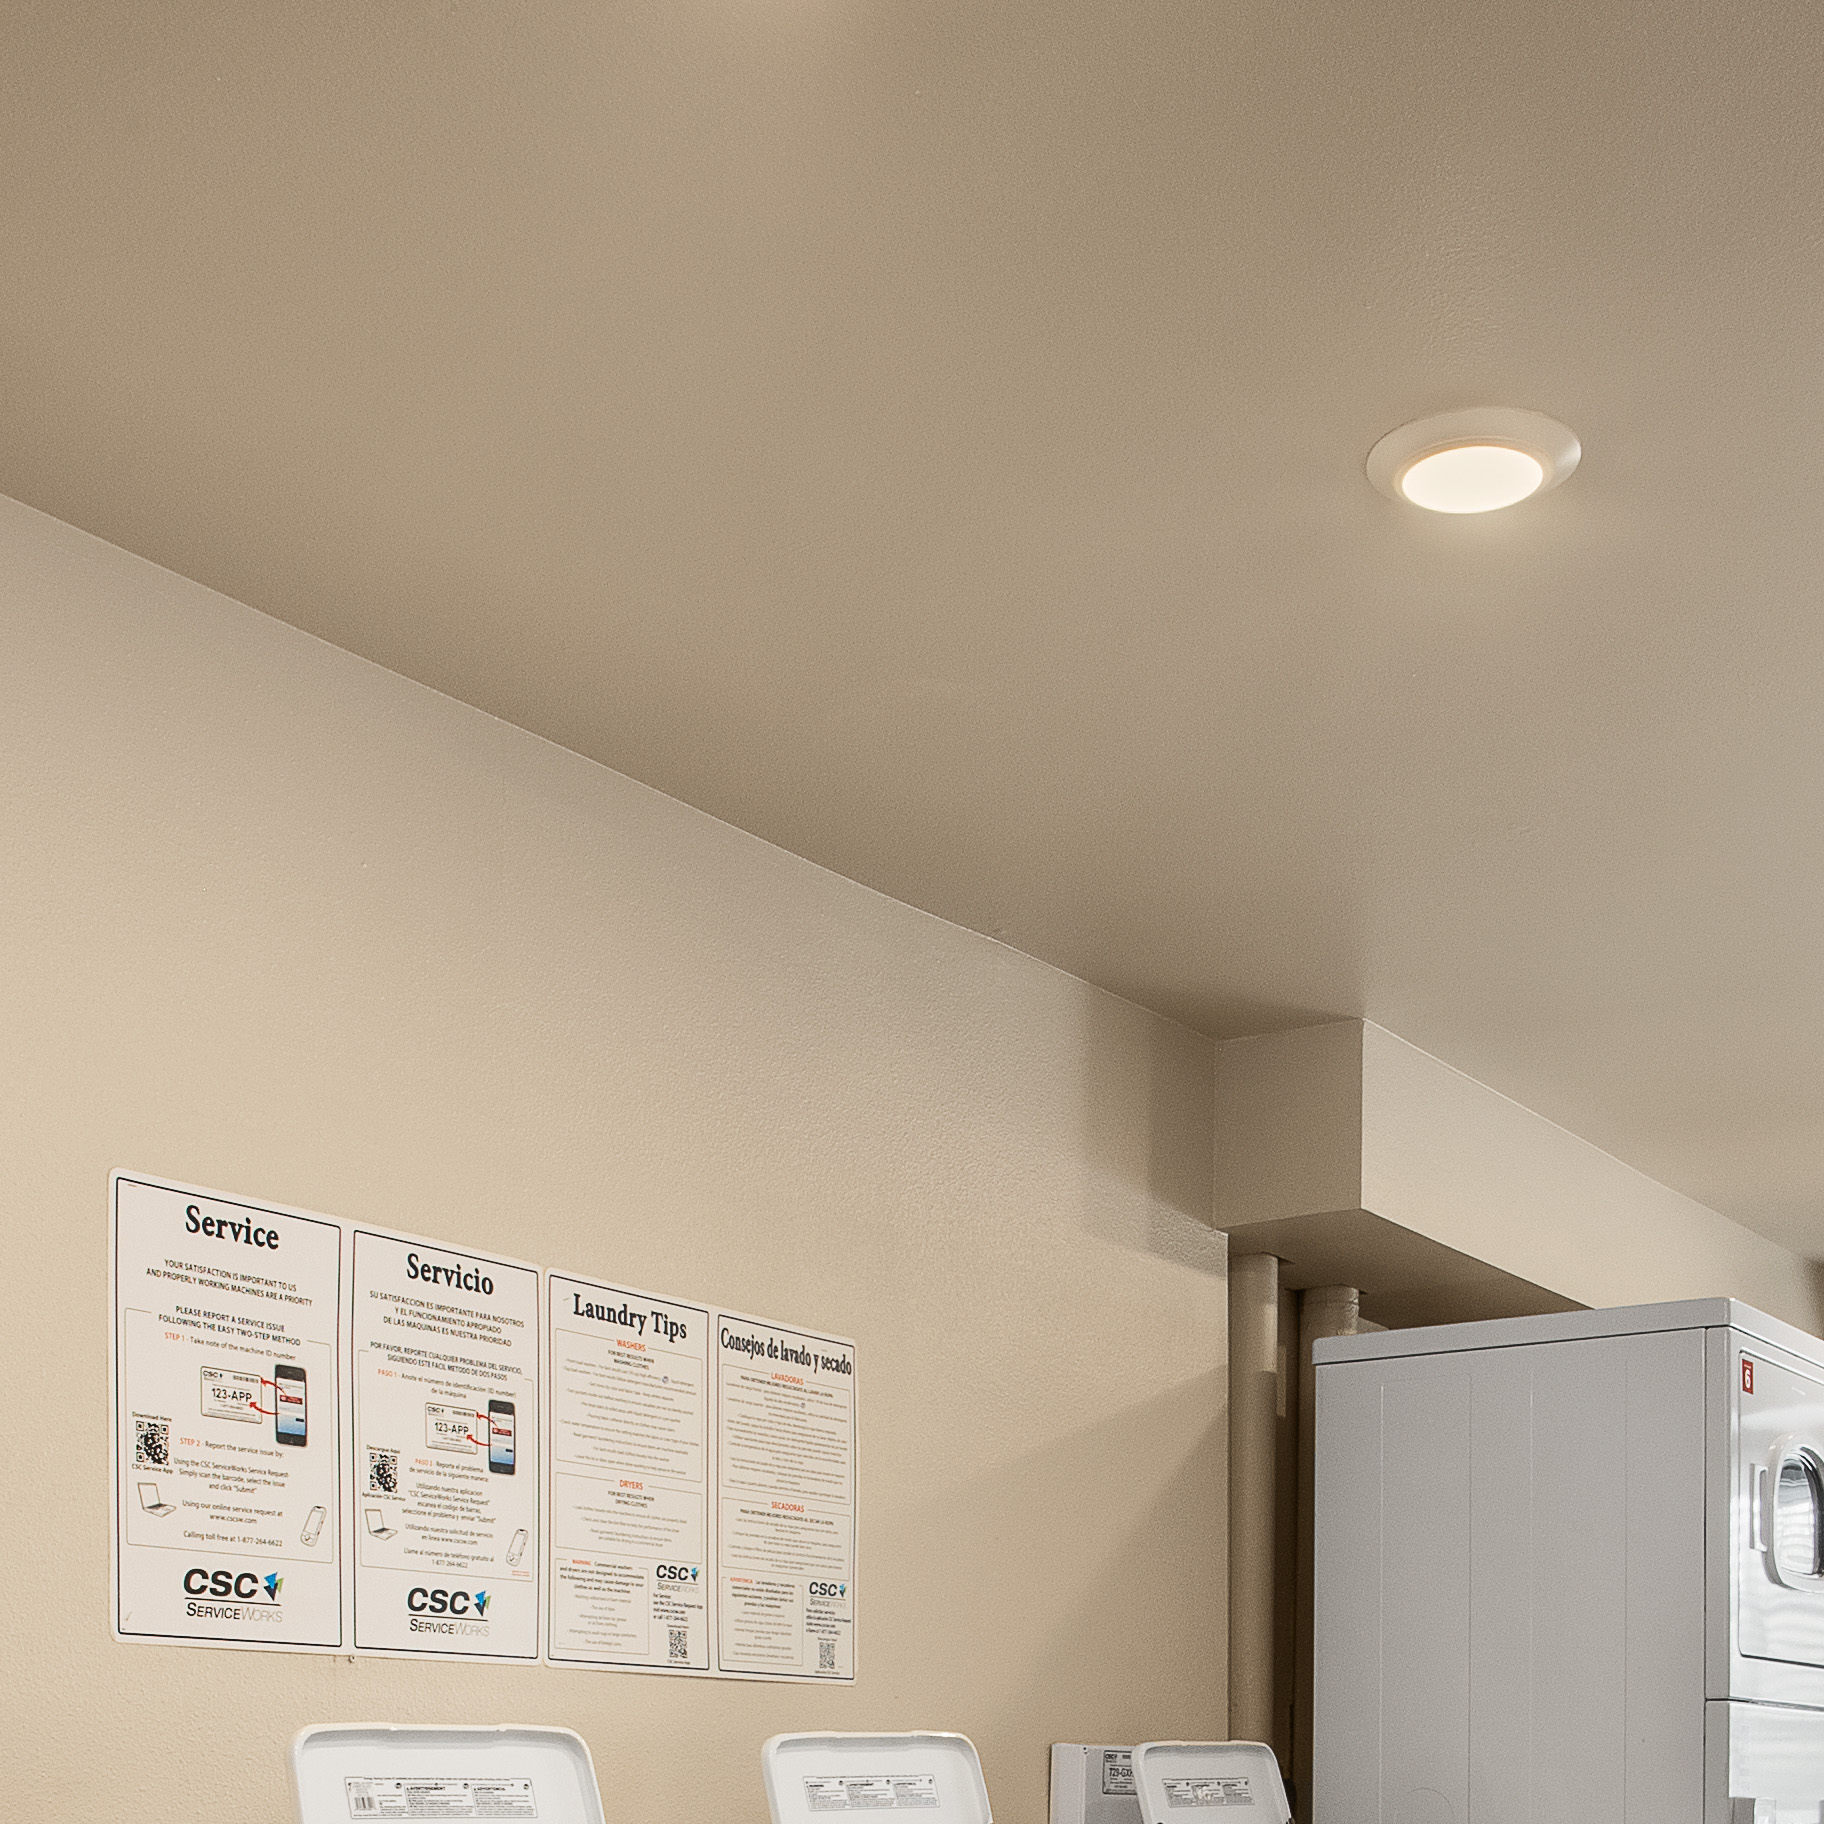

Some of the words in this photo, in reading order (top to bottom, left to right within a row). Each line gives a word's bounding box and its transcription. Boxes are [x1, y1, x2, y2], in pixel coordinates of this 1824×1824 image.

[185, 1205, 279, 1249] Service
[165, 1259, 183, 1270] YOUR
[185, 1262, 231, 1279] SATISFACTION
[233, 1272, 238, 1280] IS
[240, 1273, 277, 1288] IMPORTANT
[288, 1283, 296, 1291] US
[407, 1253, 494, 1295] Servicio
[146, 1268, 161, 1278] AND
[163, 1271, 196, 1285] PROPERLY
[198, 1278, 229, 1291] WORKING
[231, 1284, 264, 1297] MACHINES
[266, 1291, 277, 1300] ARE
[285, 1294, 312, 1306] PRIORITY
[176, 1306, 201, 1318] PLEASE
[203, 1311, 229, 1323] REPORT
[238, 1317, 265, 1329] SERVICE
[266, 1323, 285, 1332] ISSUE
[573, 1293, 647, 1336] Laundry
[651, 1311, 686, 1343] Tips
[159, 1314, 201, 1329] FOLLOWING
[203, 1322, 216, 1331] THE
[217, 1324, 234, 1334] EASY
[237, 1328, 270, 1340] TWO-STEP
[272, 1334, 300, 1346] METHOD
[616, 1339, 646, 1352] WASHERS
[721, 1328, 765, 1359] Consejos
[767, 1338, 778, 1359] de
[780, 1340, 811, 1366] lavado
[814, 1354, 818, 1373] y
[821, 1354, 851, 1375] secado
[771, 1373, 804, 1385] LAVADORAS
[1745, 1370, 1751, 1389] 6
[211, 1388, 252, 1402] 123-APP
[435, 1422, 469, 1435] 123-APP
[620, 1480, 643, 1490] DRYERS
[772, 1502, 804, 1512] SECADORAS
[237, 1536, 282, 1547] 1-877-264-6622
[183, 1568, 258, 1599] CSC
[657, 1565, 688, 1580] CSC
[809, 1582, 837, 1596] CSC
[408, 1587, 470, 1614] CSC
